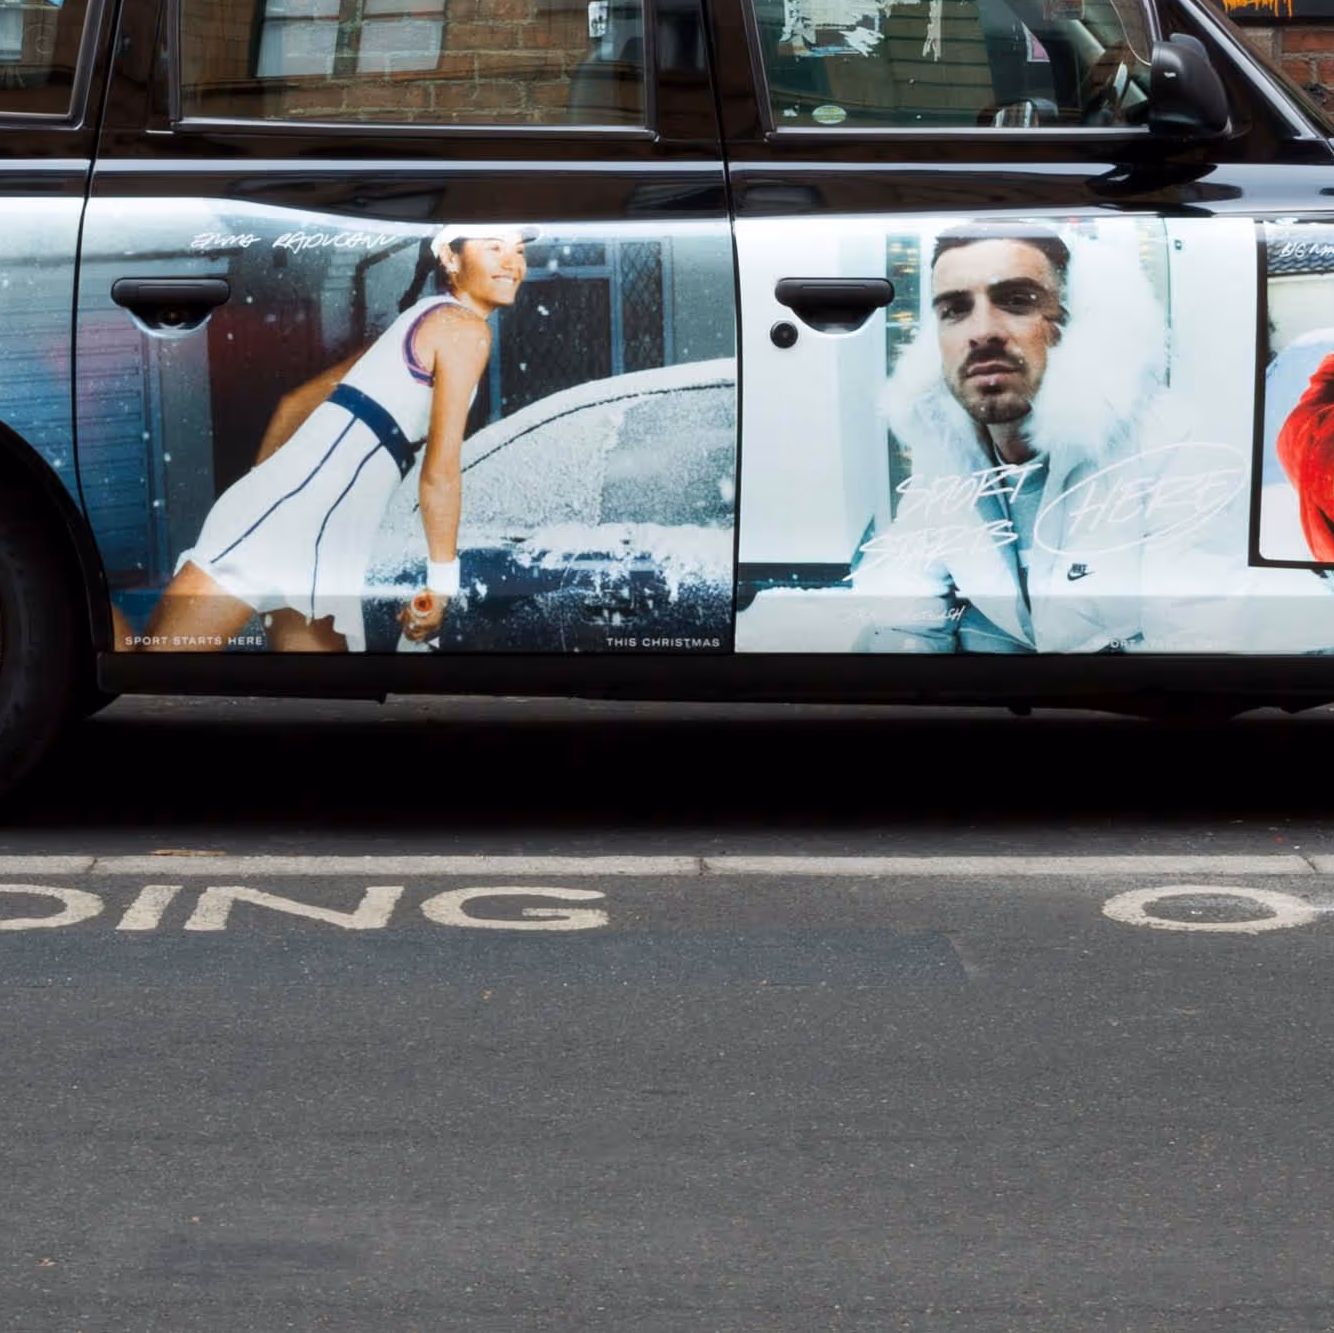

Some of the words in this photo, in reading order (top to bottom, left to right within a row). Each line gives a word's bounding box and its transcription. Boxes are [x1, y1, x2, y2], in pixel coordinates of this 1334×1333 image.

[124, 635, 167, 646] SPORT
[172, 635, 222, 646] STARTS
[227, 635, 263, 646] HERE
[606, 637, 637, 647] THIS
[642, 637, 721, 648] CHRISTMAS
